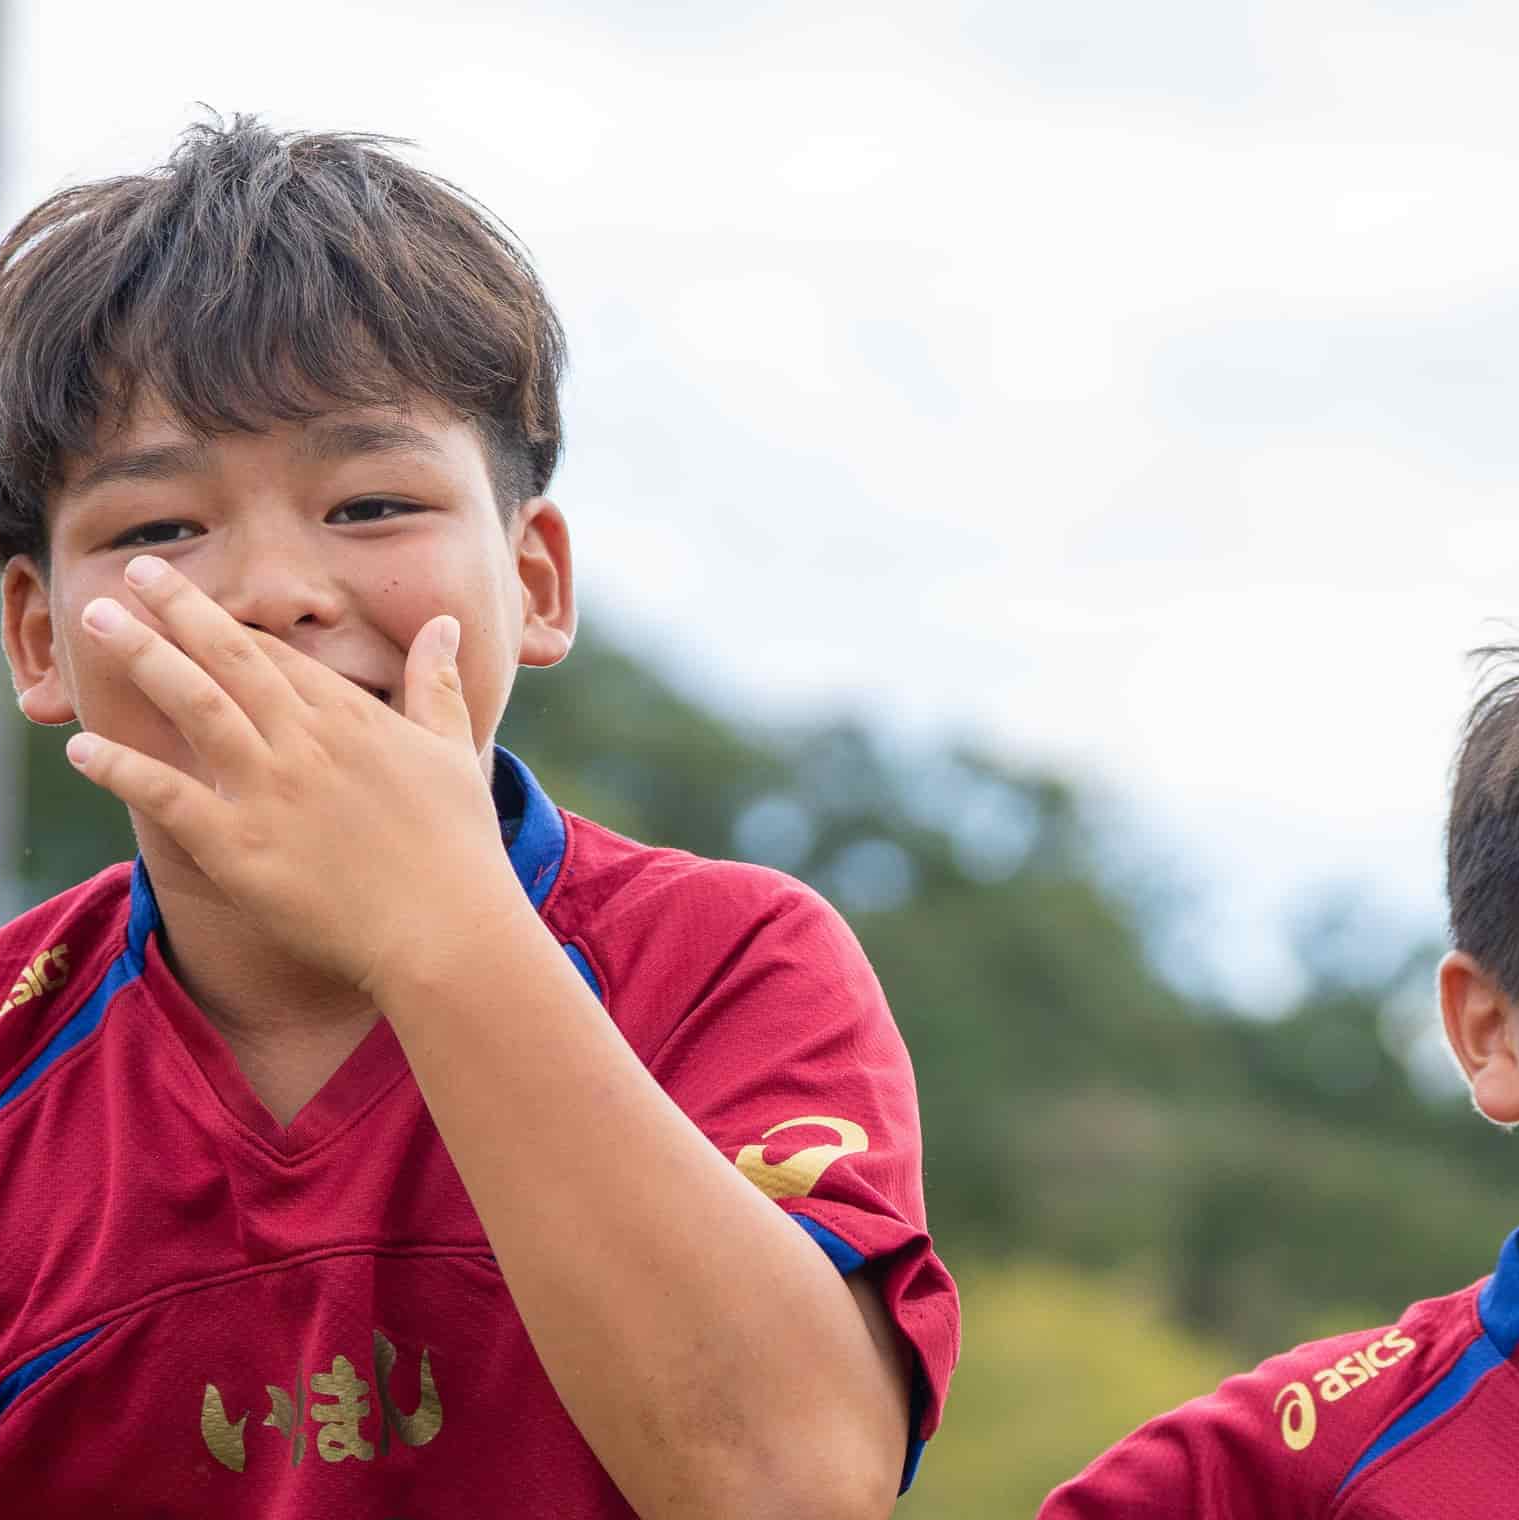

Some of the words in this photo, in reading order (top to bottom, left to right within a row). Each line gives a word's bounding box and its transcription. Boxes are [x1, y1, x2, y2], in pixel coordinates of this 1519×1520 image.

[201, 1328, 443, 1473] いまん
[1313, 1328, 1417, 1402] asics
